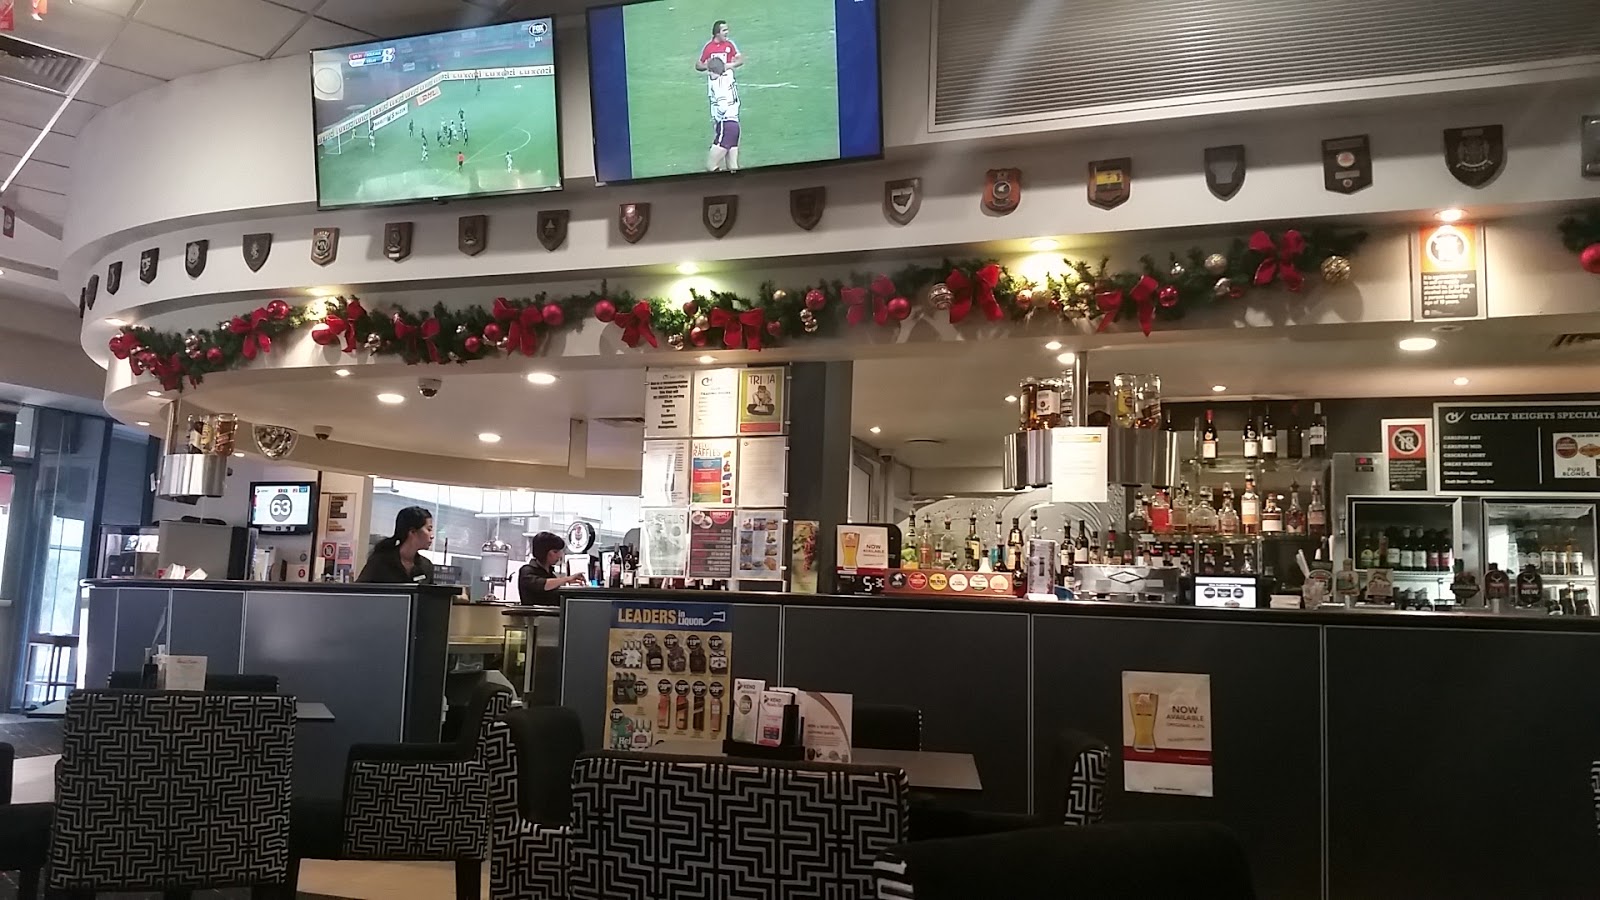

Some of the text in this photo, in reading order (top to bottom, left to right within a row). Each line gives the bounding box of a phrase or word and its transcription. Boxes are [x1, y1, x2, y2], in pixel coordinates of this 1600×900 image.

[748, 374, 776, 385] TRIIA
[1470, 412, 1510, 420] CANLEY
[1511, 412, 1556, 420] HEIGHTS
[270, 499, 291, 516] 63
[617, 607, 677, 625] LEADERS
[678, 617, 704, 626] LIQUOR
[1172, 705, 1198, 714] NOW
[1166, 714, 1204, 722] AVAILABLE
